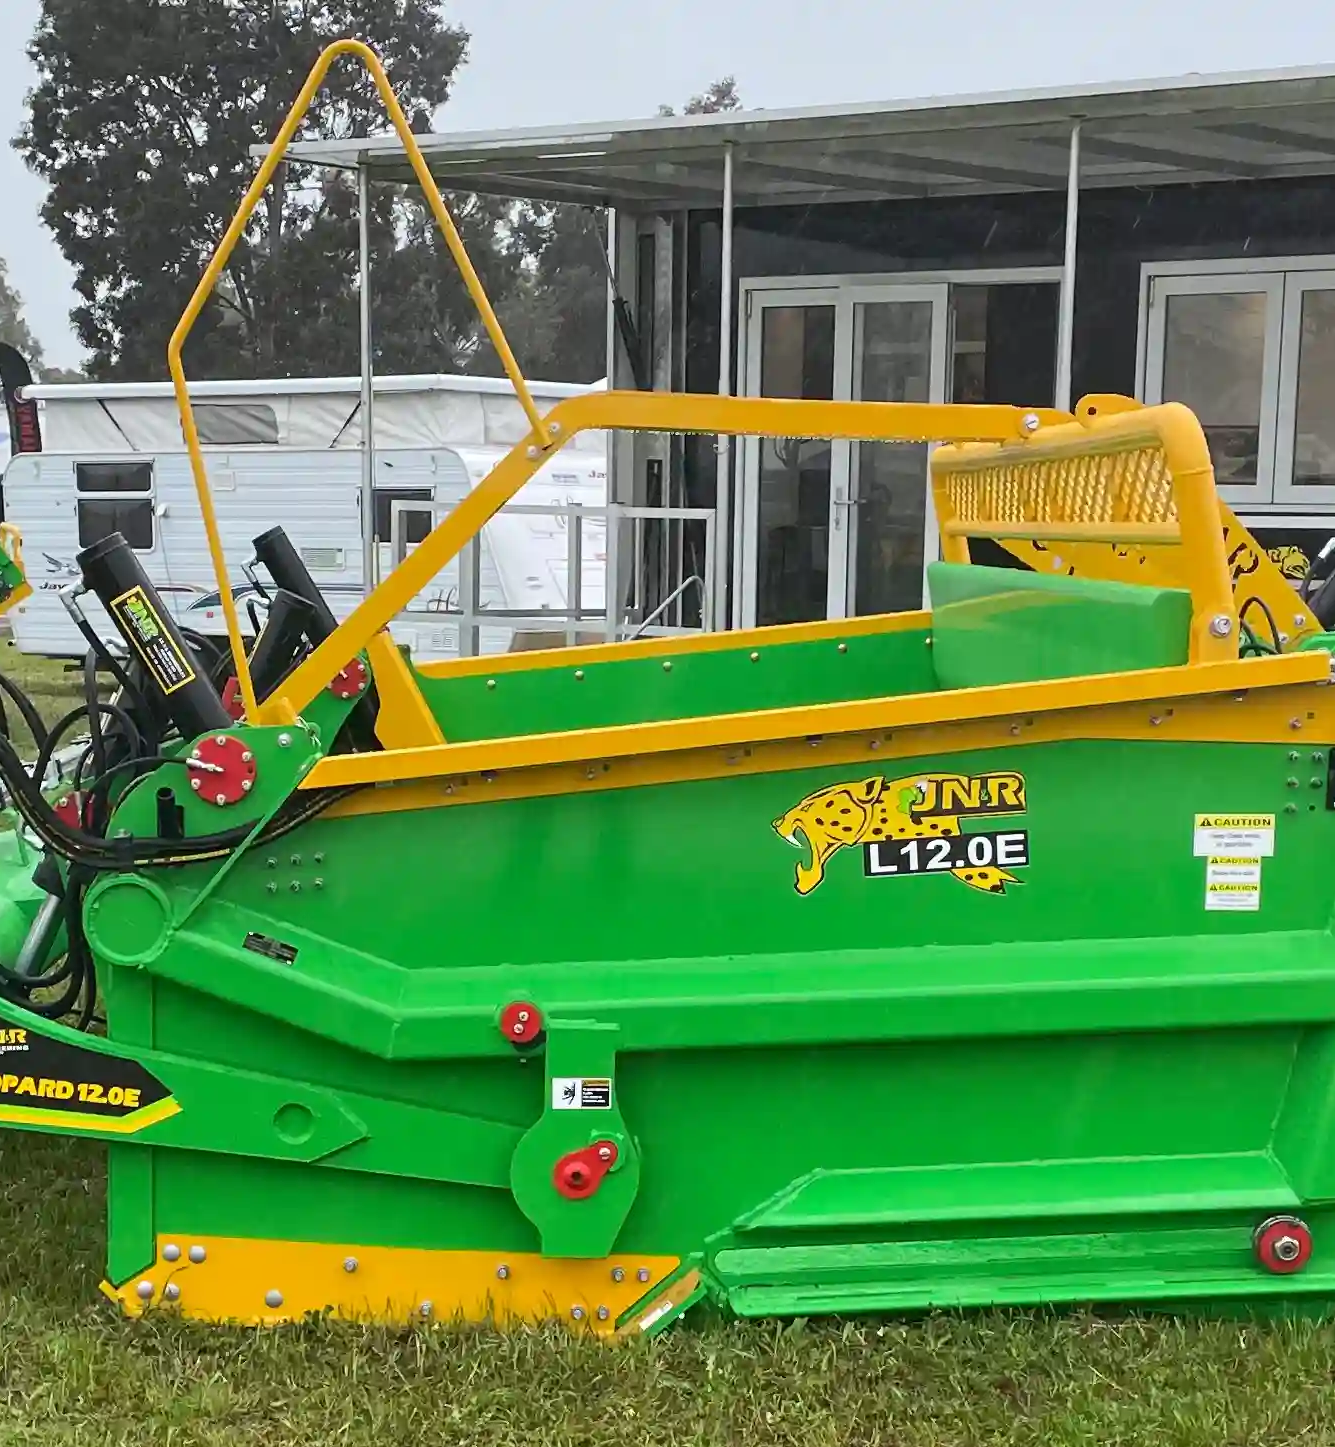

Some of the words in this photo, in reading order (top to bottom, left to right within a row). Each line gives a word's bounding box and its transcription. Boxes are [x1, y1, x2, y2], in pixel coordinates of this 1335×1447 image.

[1214, 818, 1271, 826] CAUTION
[868, 832, 1027, 874] L12.0E
[77, 1082, 142, 1108] 12.0E
